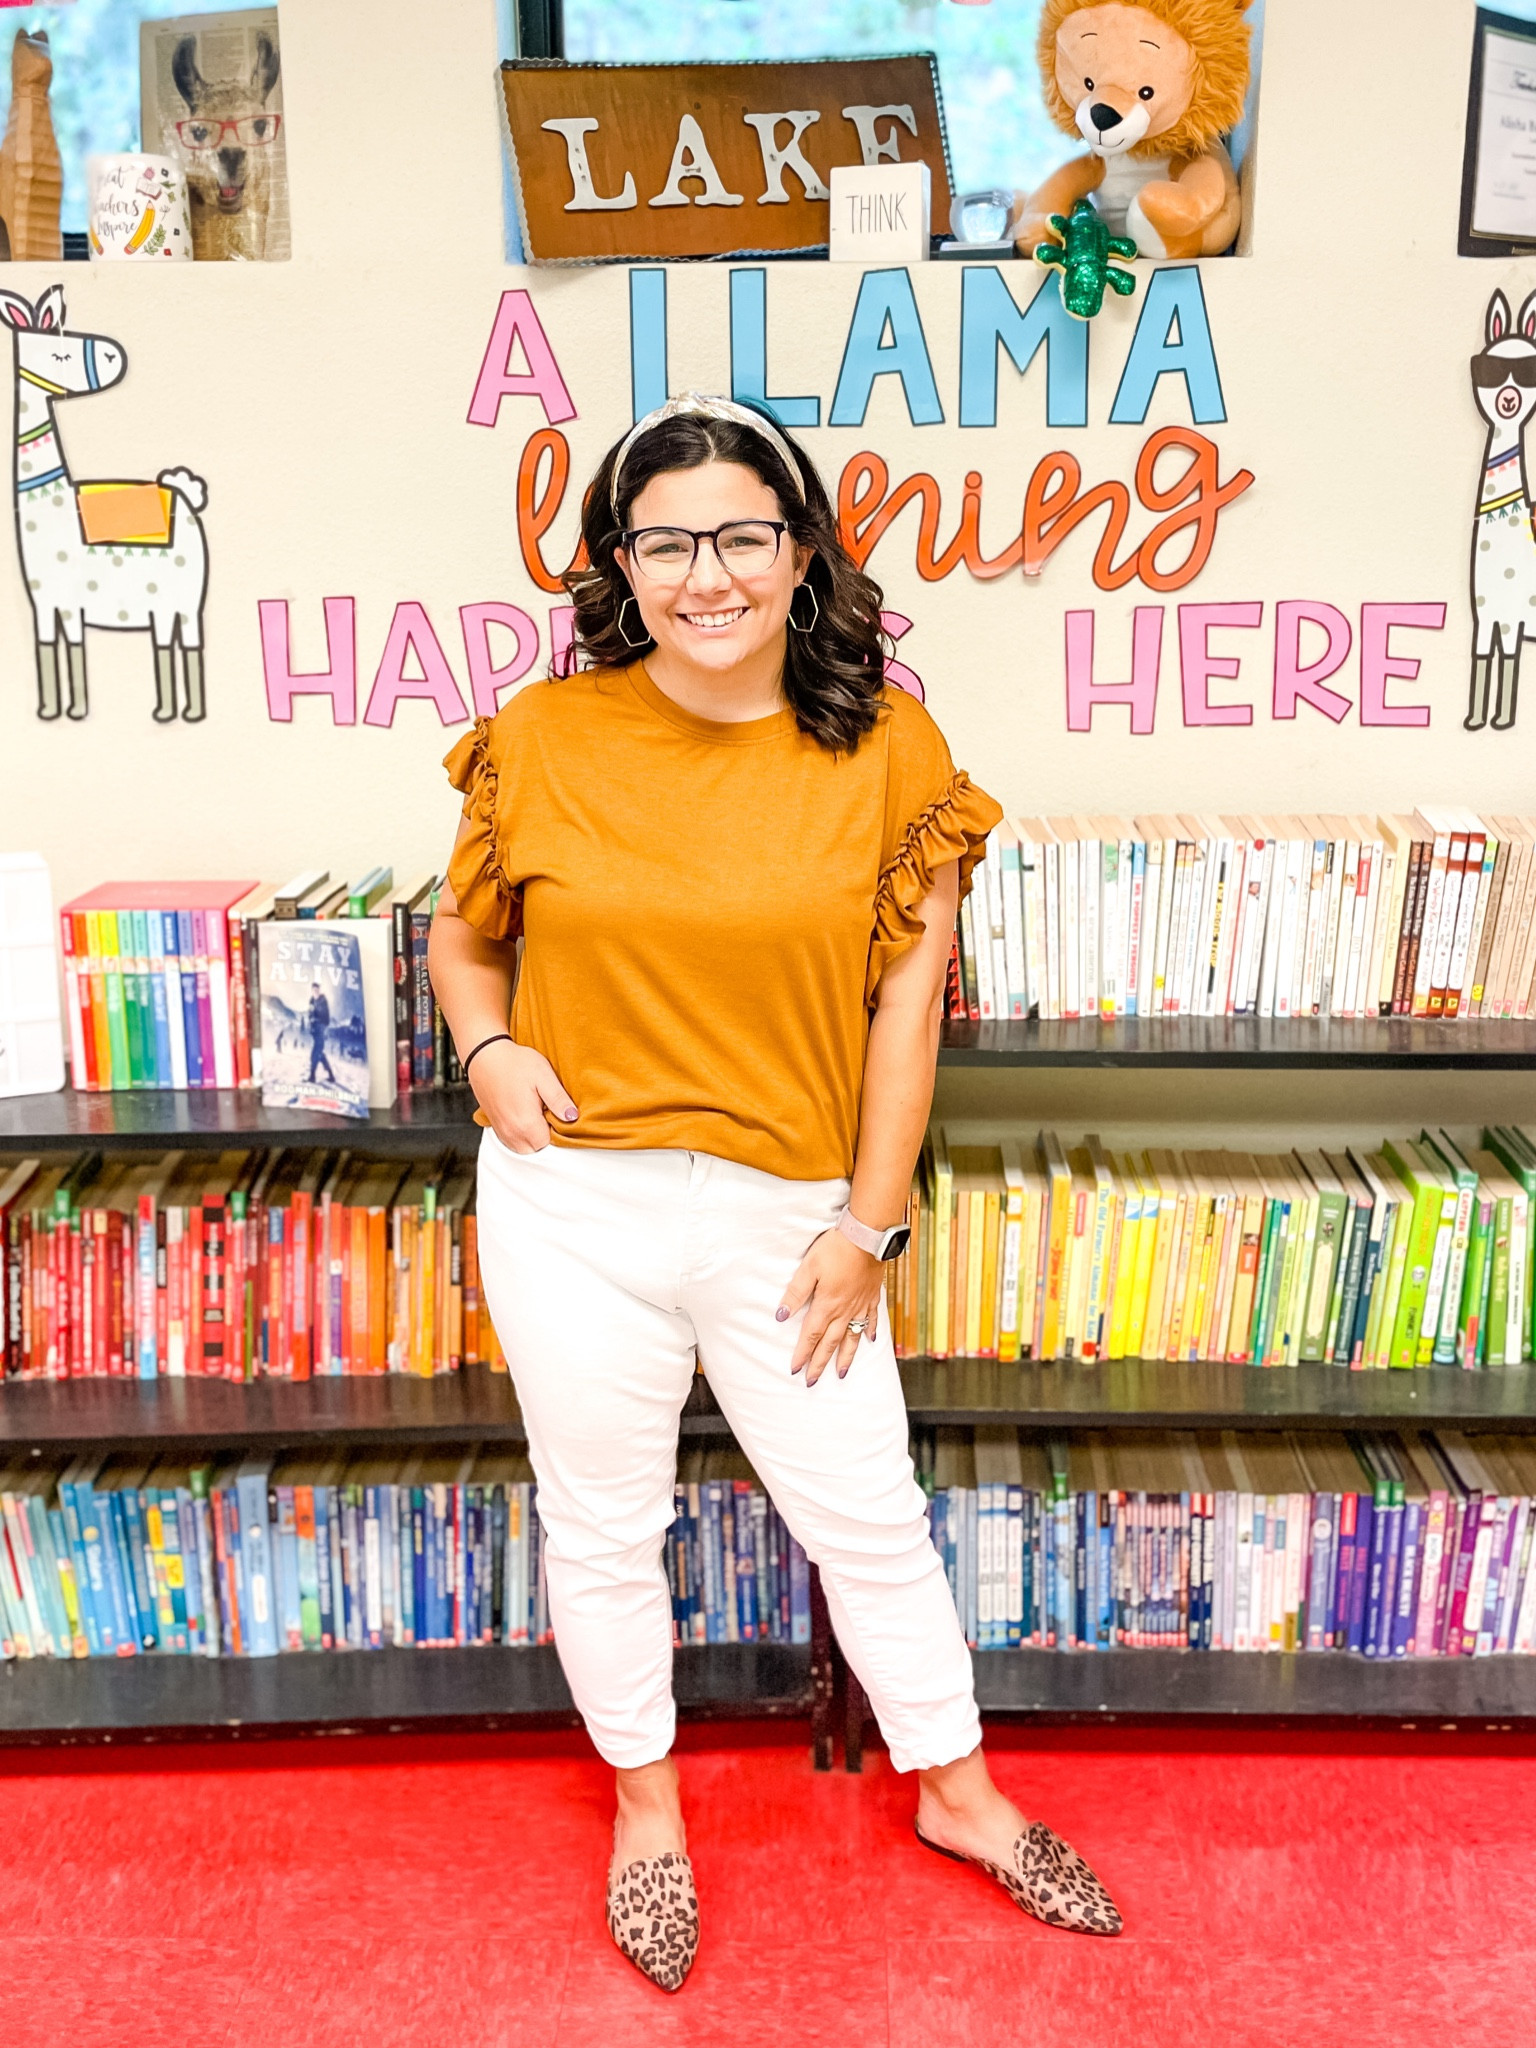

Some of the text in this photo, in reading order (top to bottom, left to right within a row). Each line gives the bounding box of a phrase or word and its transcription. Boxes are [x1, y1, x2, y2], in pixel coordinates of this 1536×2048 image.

[845, 191, 909, 235] THINK
[466, 264, 1228, 428] A LLAMA
[1063, 600, 1449, 737] HERE
[269, 962, 361, 990] ALIVE
[277, 940, 352, 968] STAY
[1128, 944, 1138, 989] PENGUINS
[421, 995, 430, 1034] POTTER
[1087, 1187, 1109, 1340] The Old Farmer's Almanac for Kids
[1496, 1255, 1506, 1276] Ruby
[1400, 1544, 1415, 1618] BLACK BEAUTY
